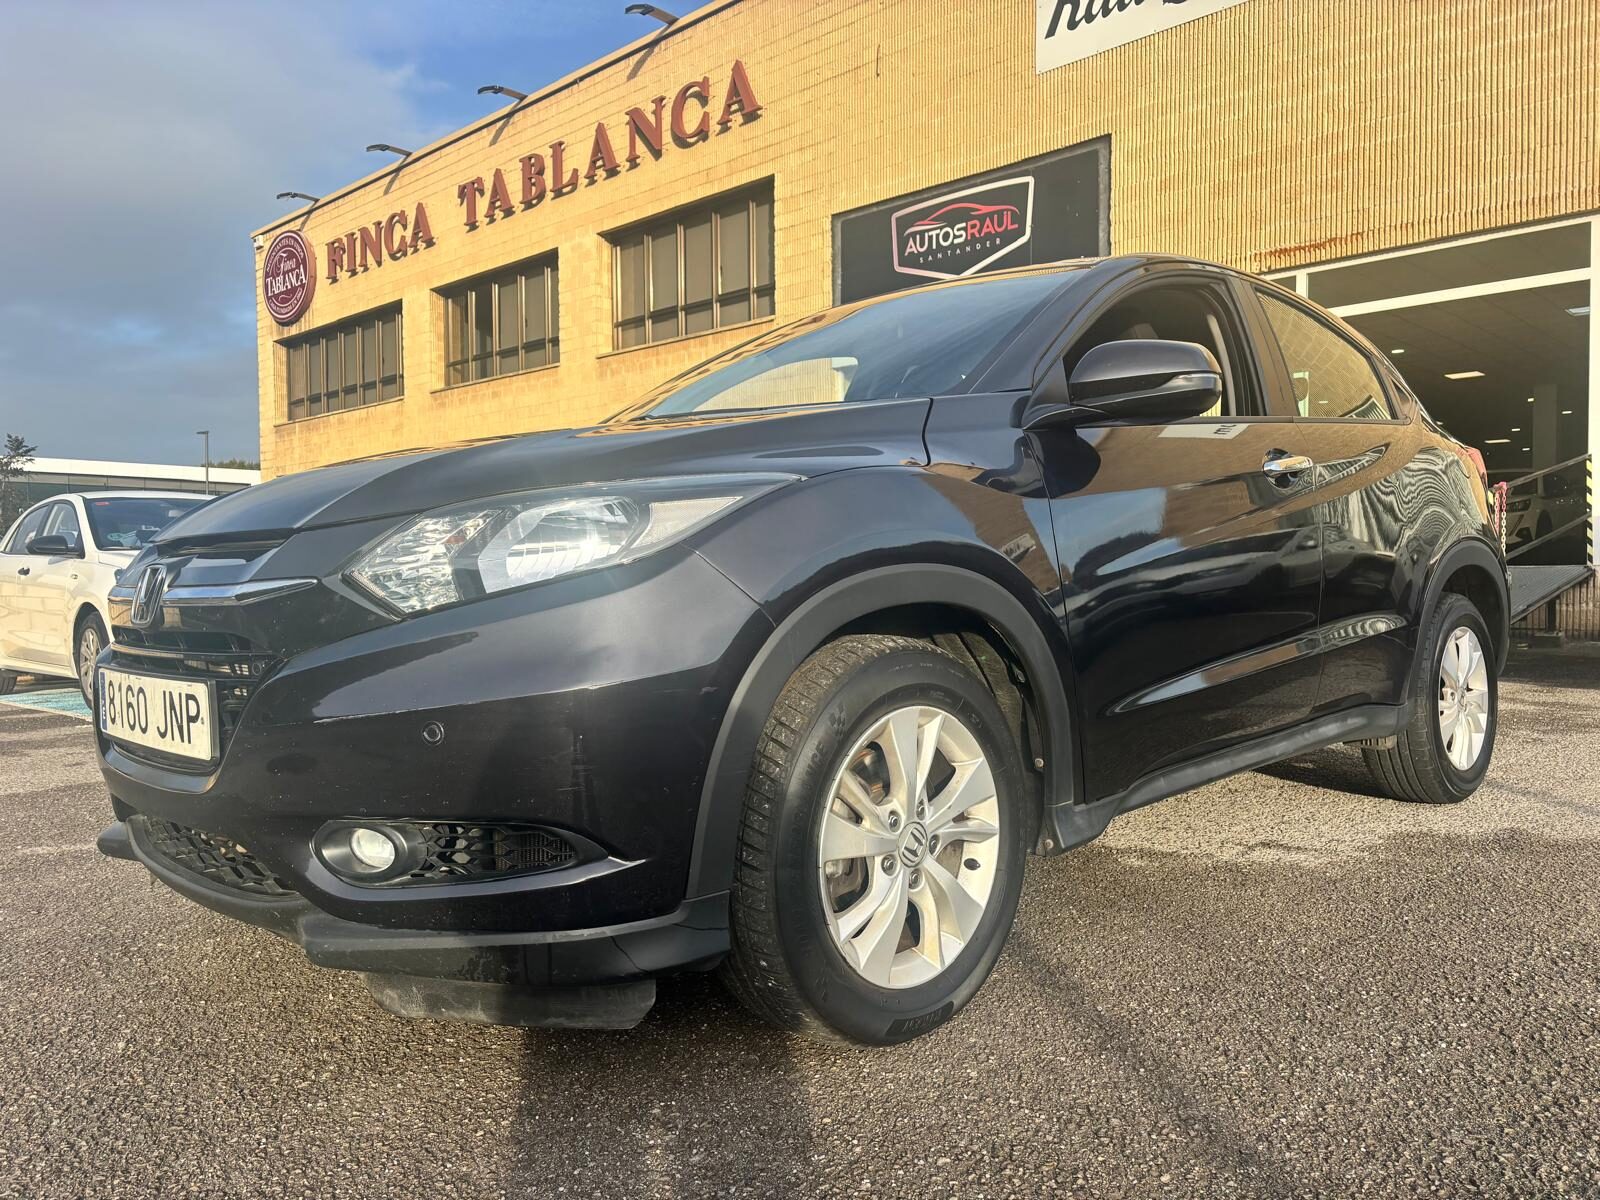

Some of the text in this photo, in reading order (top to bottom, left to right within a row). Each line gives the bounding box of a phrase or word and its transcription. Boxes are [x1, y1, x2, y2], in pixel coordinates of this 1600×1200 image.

[326, 59, 763, 280] FINCA TABLANCA
[919, 237, 1001, 264] SANTANDER
[265, 264, 306, 297] TABLANCA
[108, 680, 200, 744] 8160 JNP
